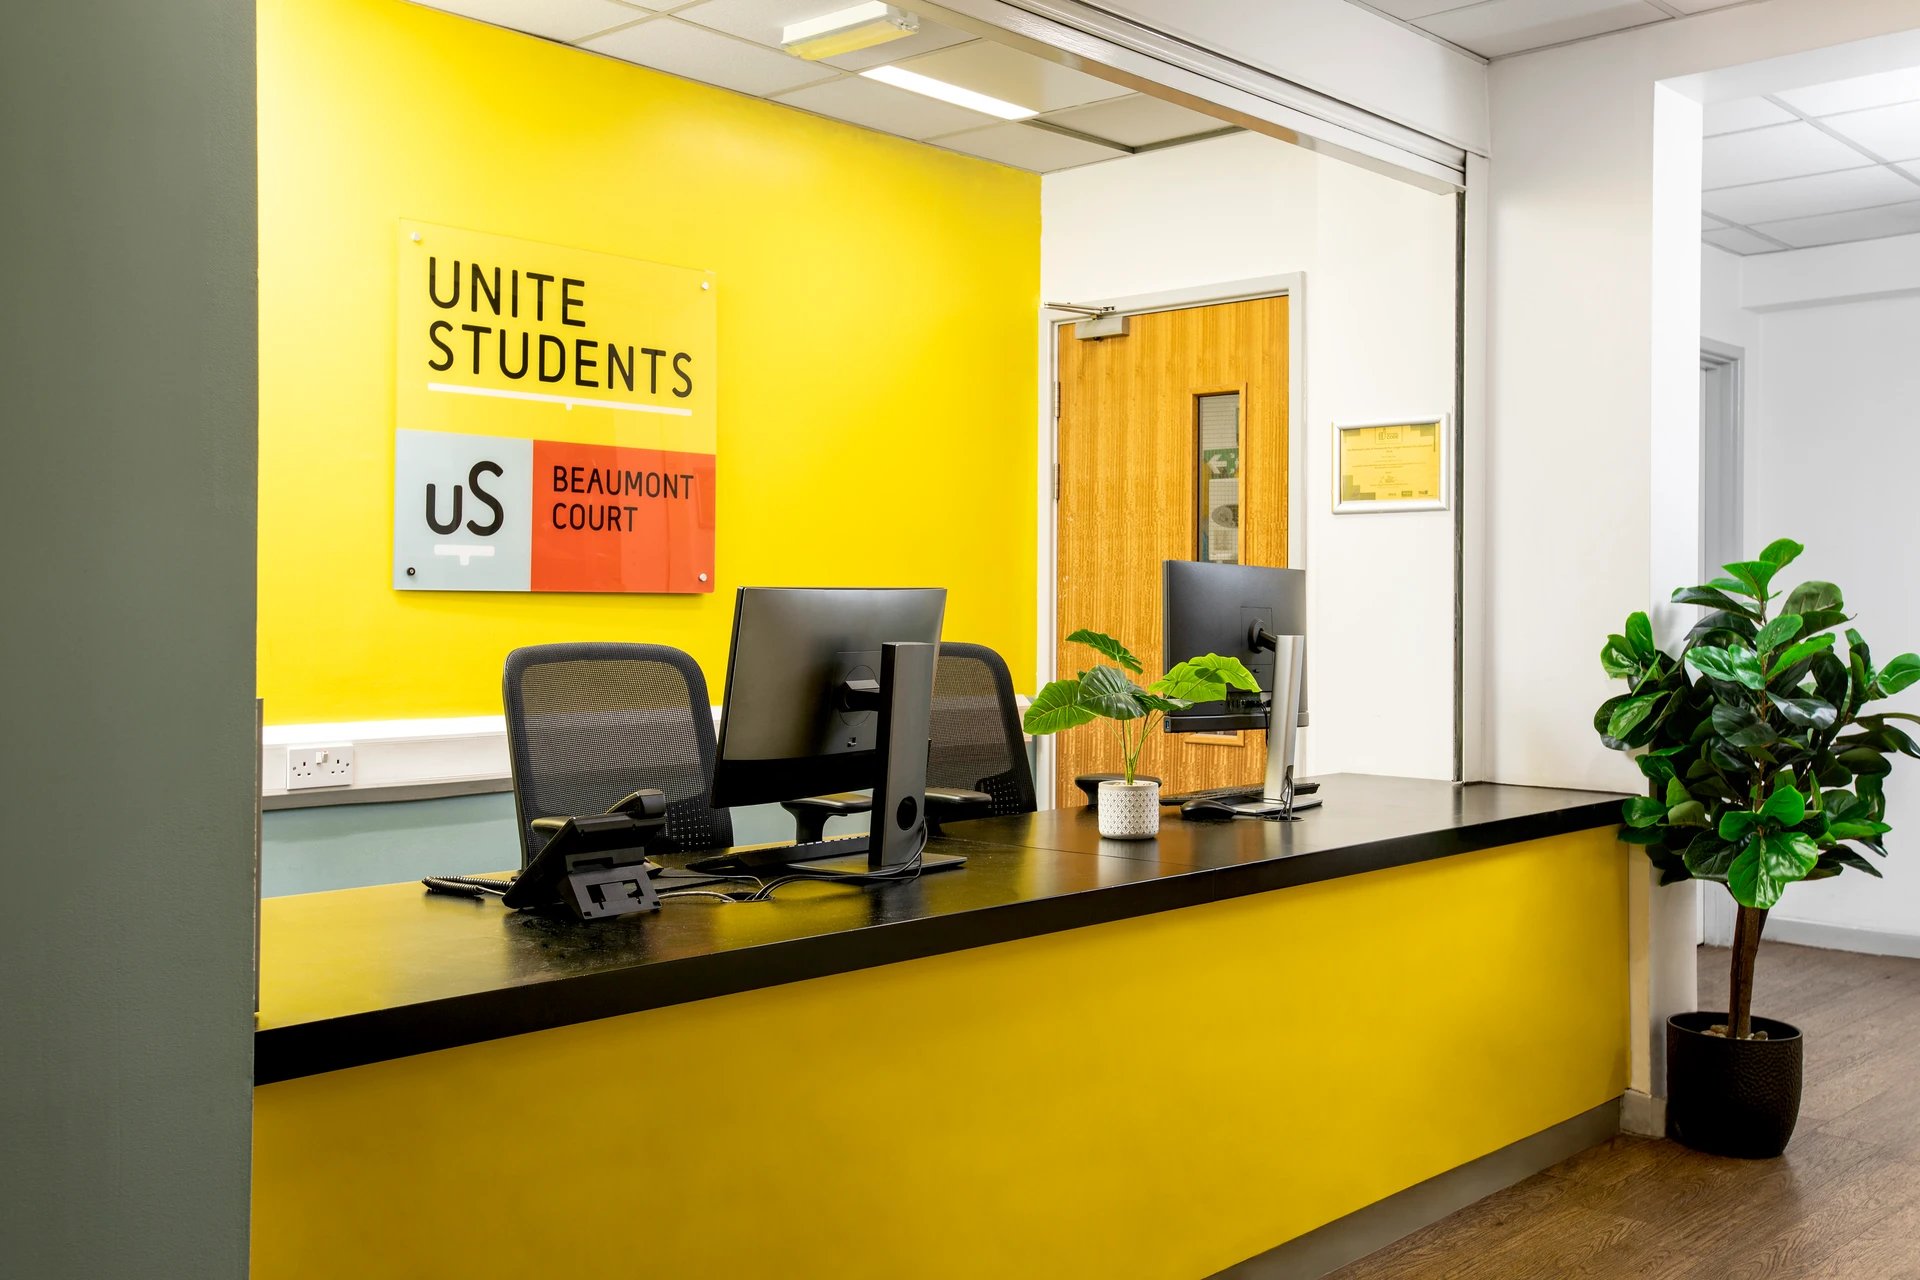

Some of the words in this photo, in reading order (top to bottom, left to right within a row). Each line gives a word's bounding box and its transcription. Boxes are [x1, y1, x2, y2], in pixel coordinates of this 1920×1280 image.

[429, 256, 586, 328] UNITE
[428, 320, 693, 398] STUDENTS
[425, 460, 505, 537] uS
[552, 502, 638, 532] COURT
[553, 465, 694, 499] BEAUMONT
